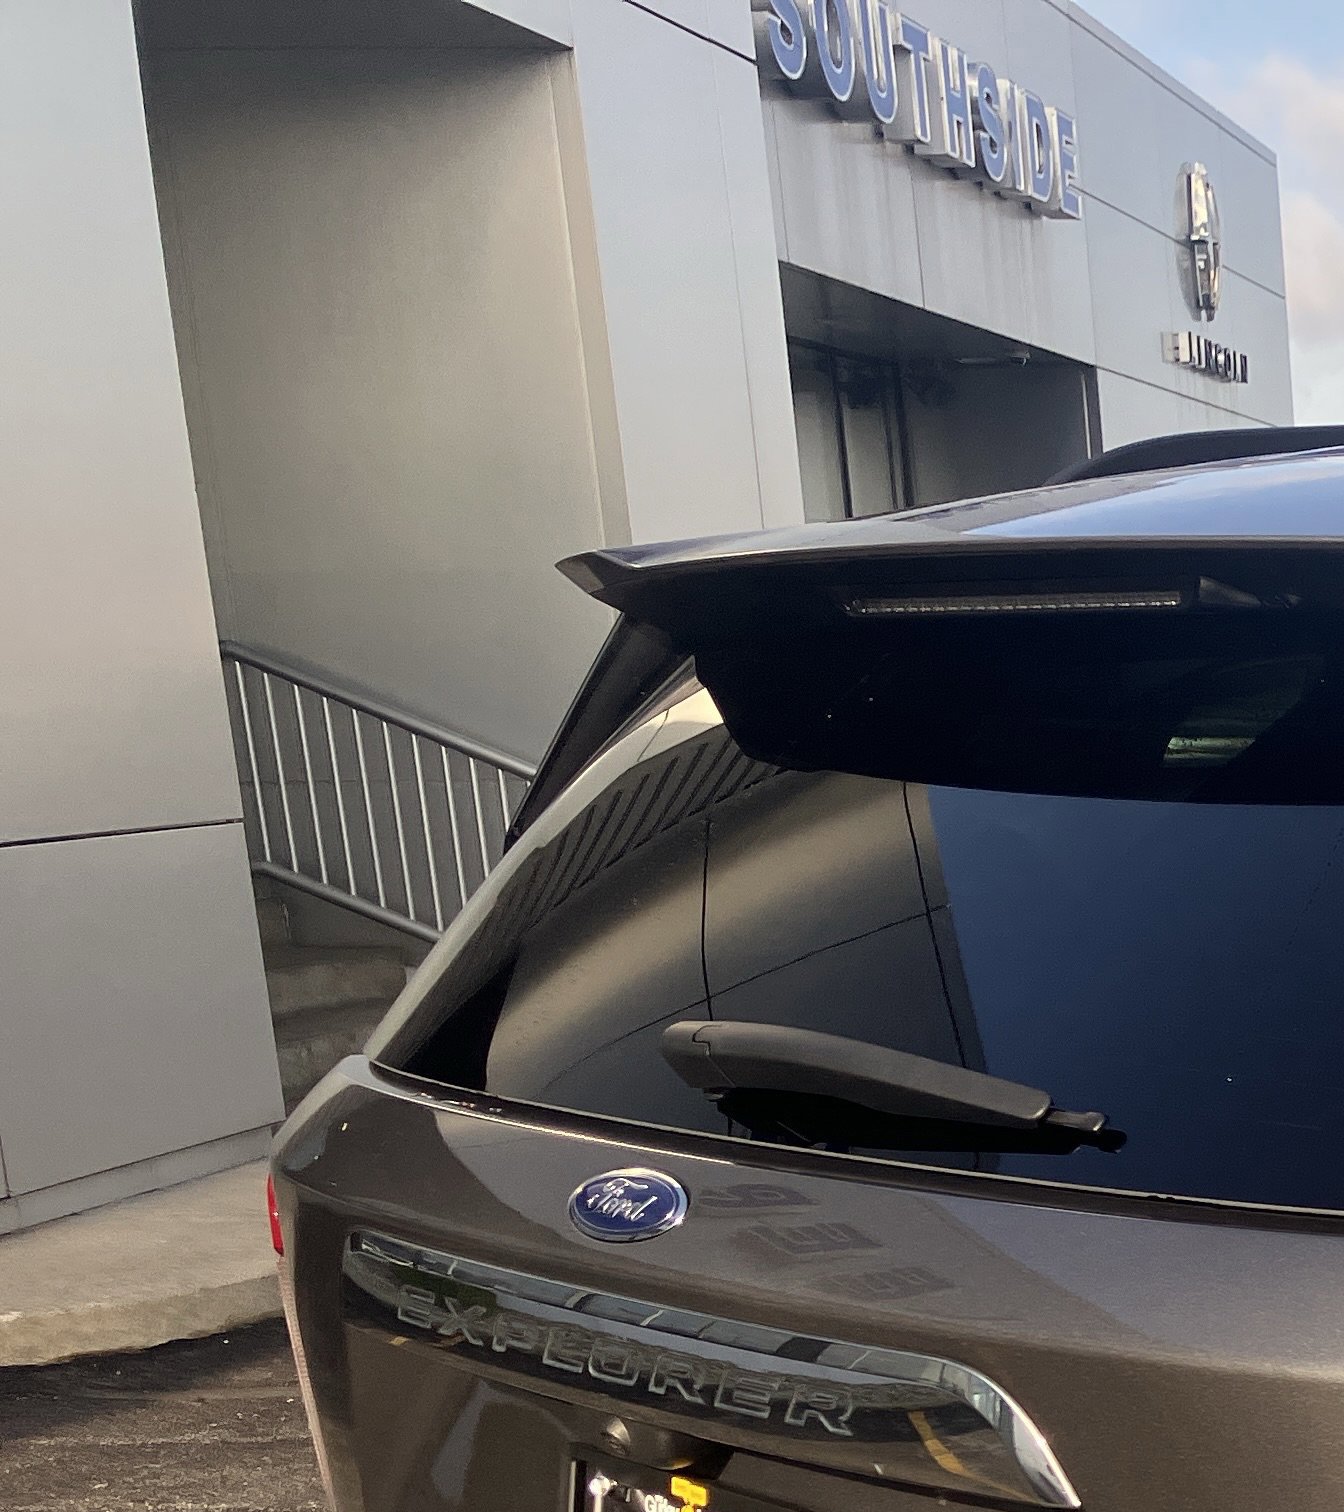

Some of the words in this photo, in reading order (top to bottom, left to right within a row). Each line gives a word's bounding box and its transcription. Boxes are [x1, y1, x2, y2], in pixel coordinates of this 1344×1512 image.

[767, 0, 1082, 220] SOUTHSIDE
[585, 1177, 658, 1222] Ford
[396, 1283, 854, 1437] EXPLORER
